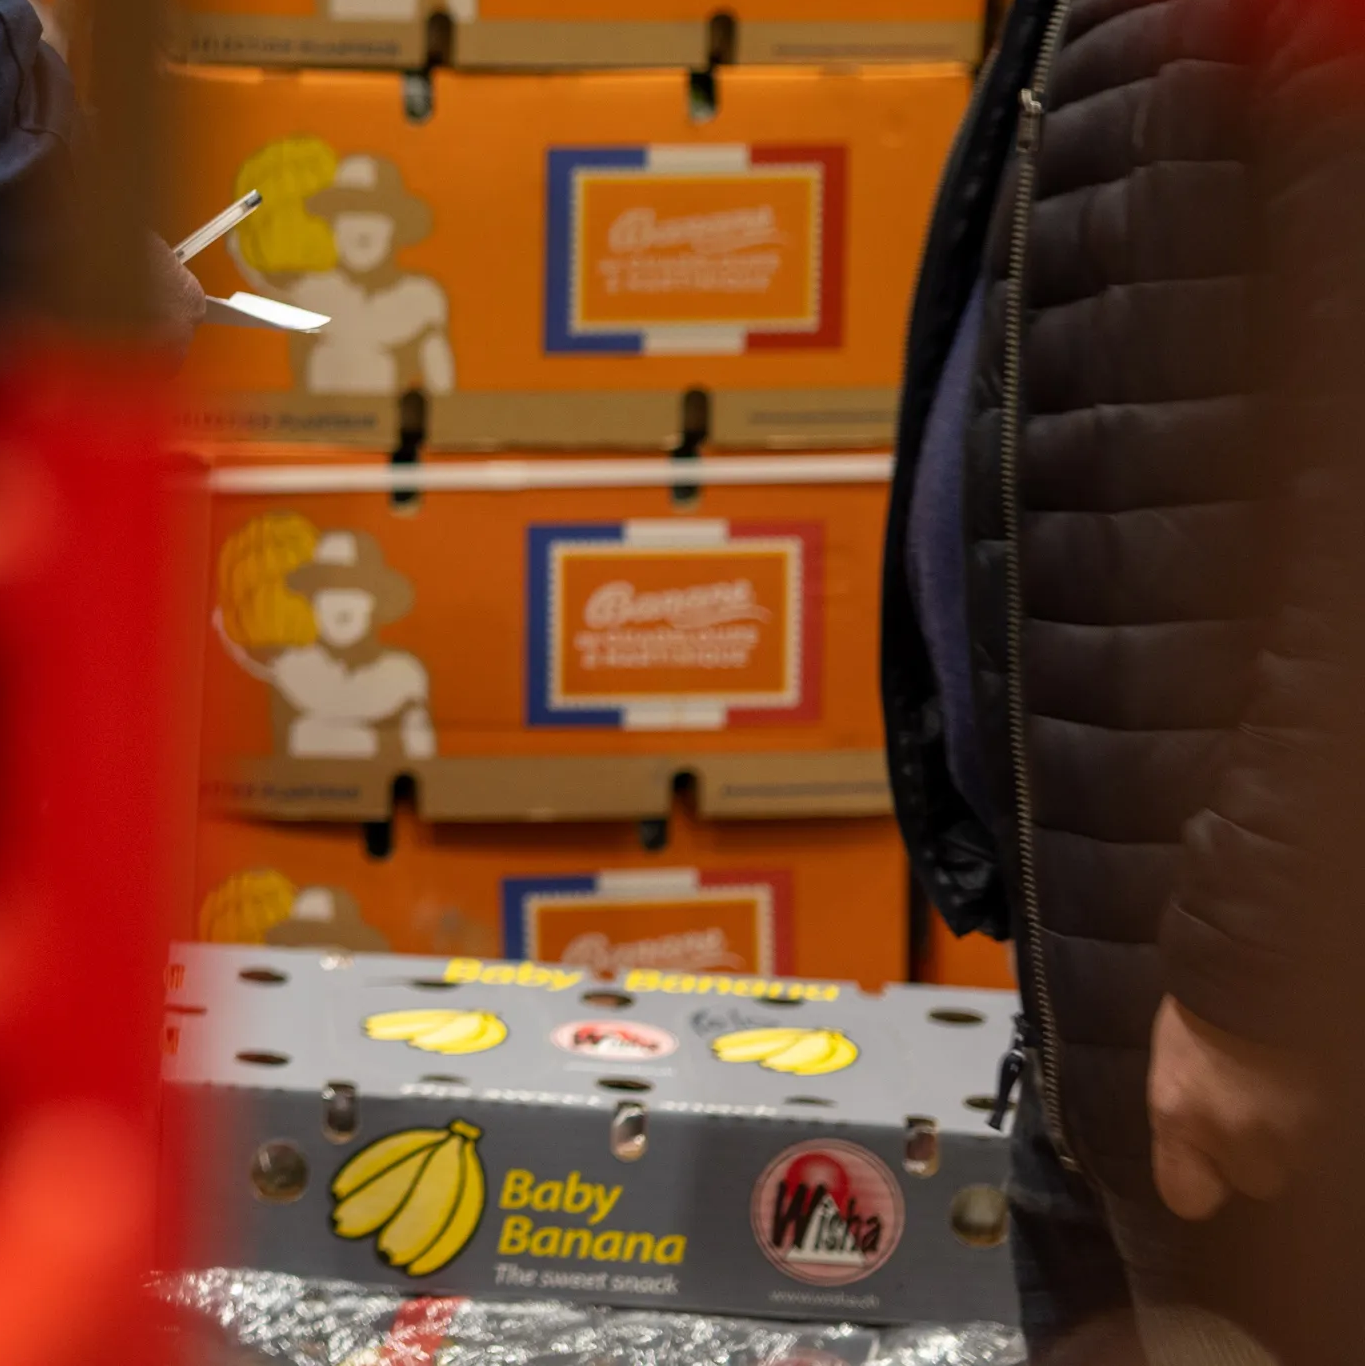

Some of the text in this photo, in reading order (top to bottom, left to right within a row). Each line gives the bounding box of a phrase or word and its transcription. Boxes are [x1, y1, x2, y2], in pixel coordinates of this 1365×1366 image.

[444, 957, 841, 1002] Baby Banana
[498, 1168, 623, 1226] Baby
[771, 1177, 882, 1255] Wisha
[496, 1215, 687, 1266] Banana
[494, 1262, 680, 1296] The sweet snack
